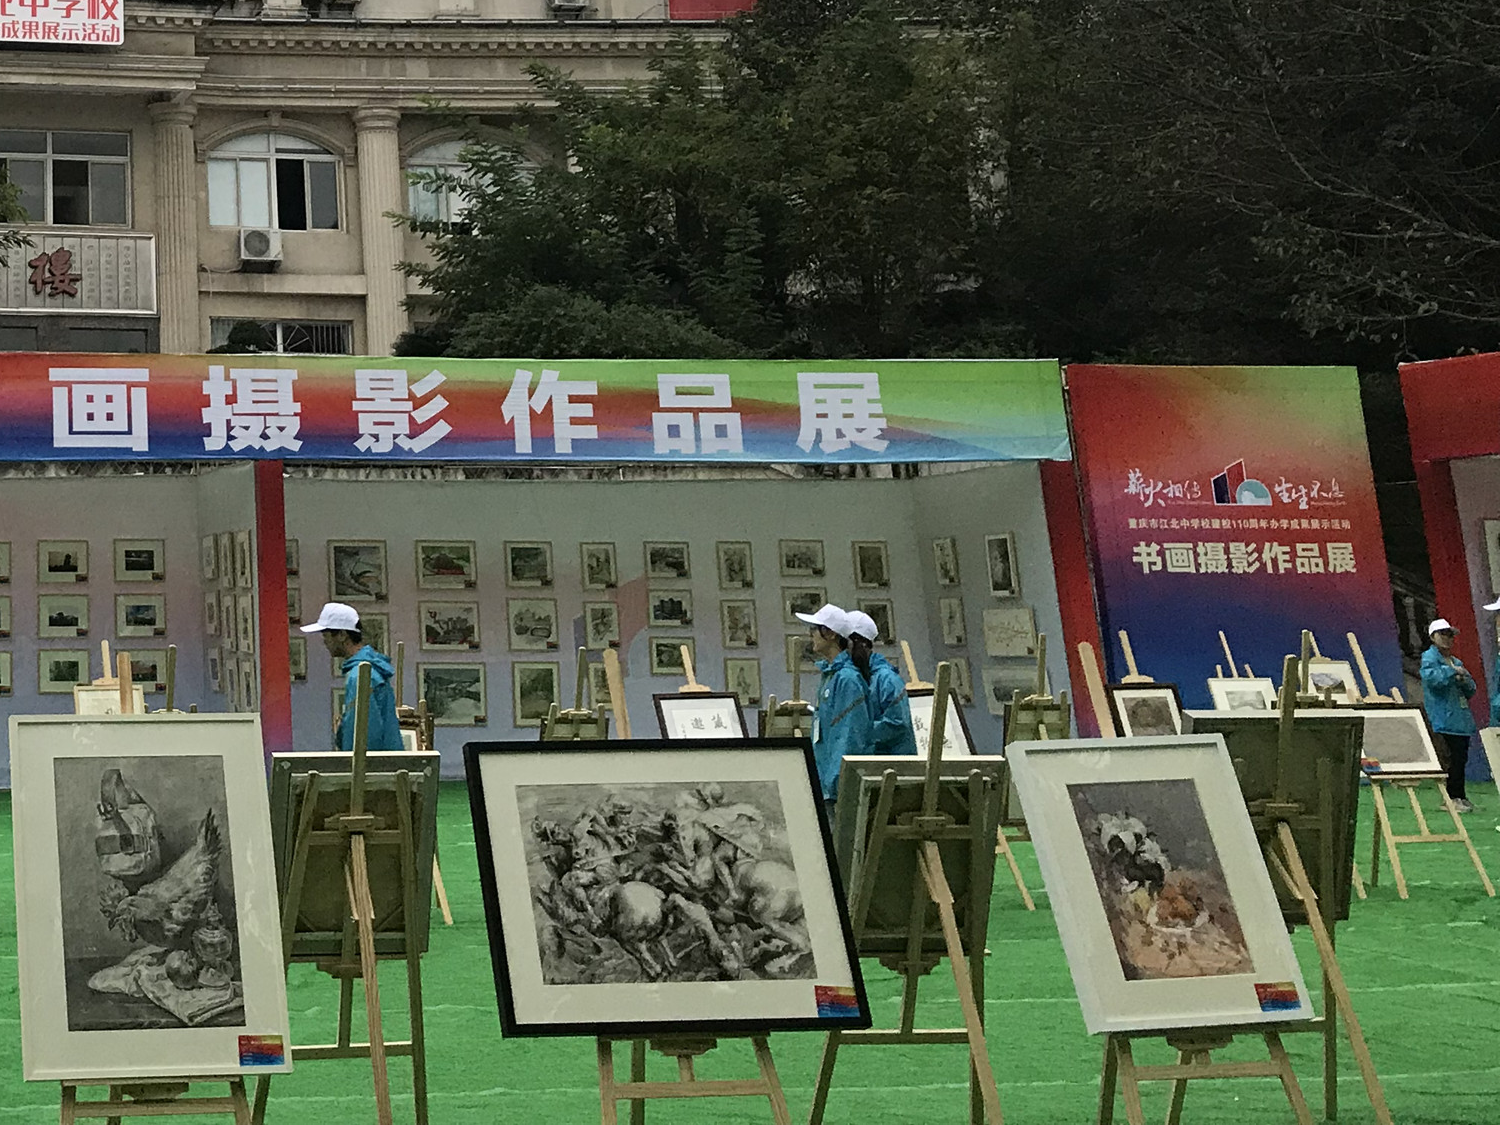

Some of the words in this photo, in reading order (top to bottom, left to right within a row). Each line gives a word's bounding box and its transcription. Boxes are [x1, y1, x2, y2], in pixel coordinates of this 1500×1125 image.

[1132, 541, 1357, 574] 书画摄影作品展
